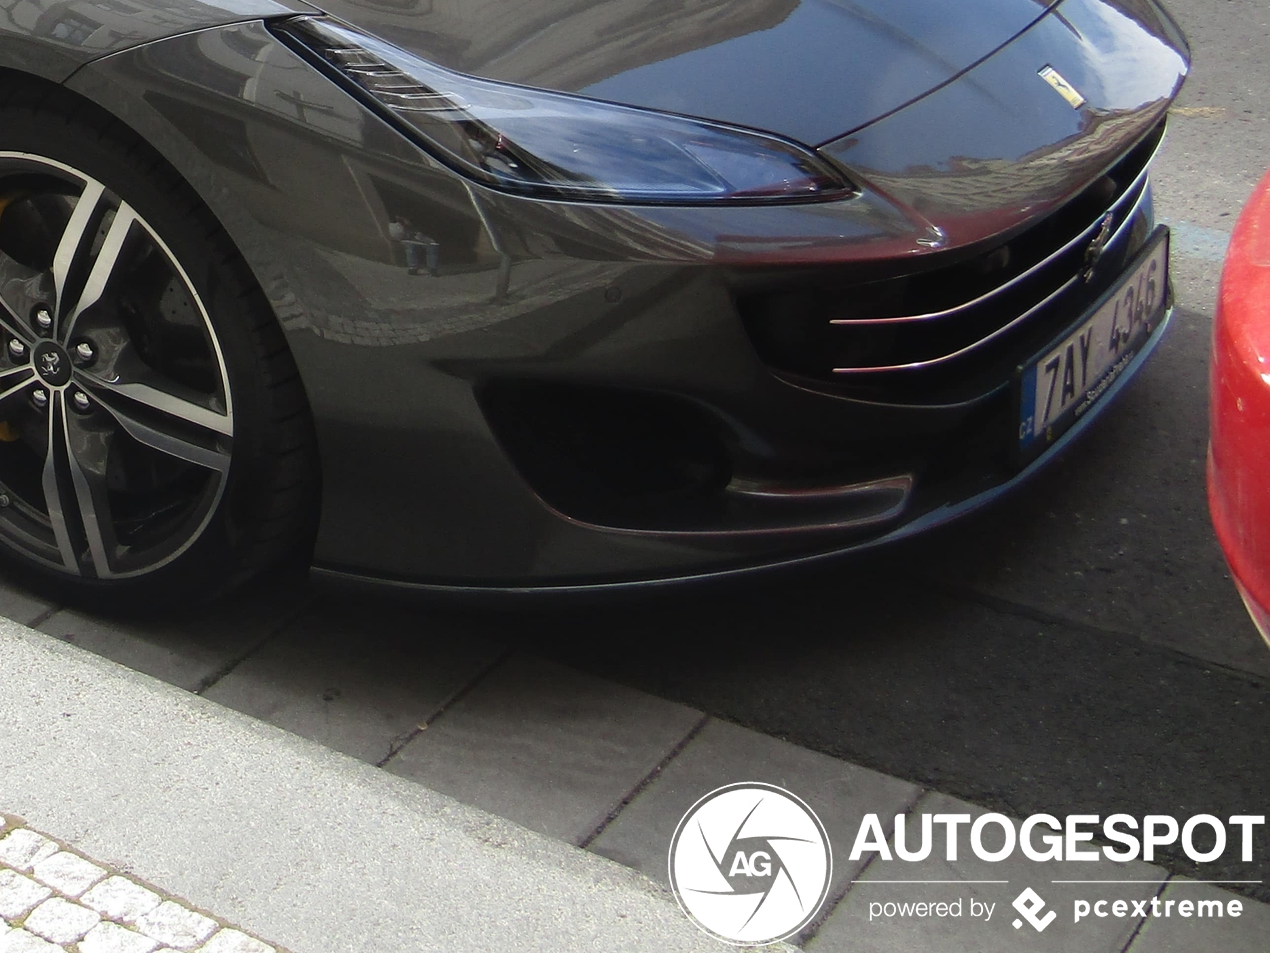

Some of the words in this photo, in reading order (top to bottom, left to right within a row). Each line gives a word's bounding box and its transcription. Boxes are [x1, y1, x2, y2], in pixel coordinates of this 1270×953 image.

[1043, 324, 1093, 423] 7AY
[1108, 258, 1157, 354] 4346
[1019, 415, 1034, 440] CZ
